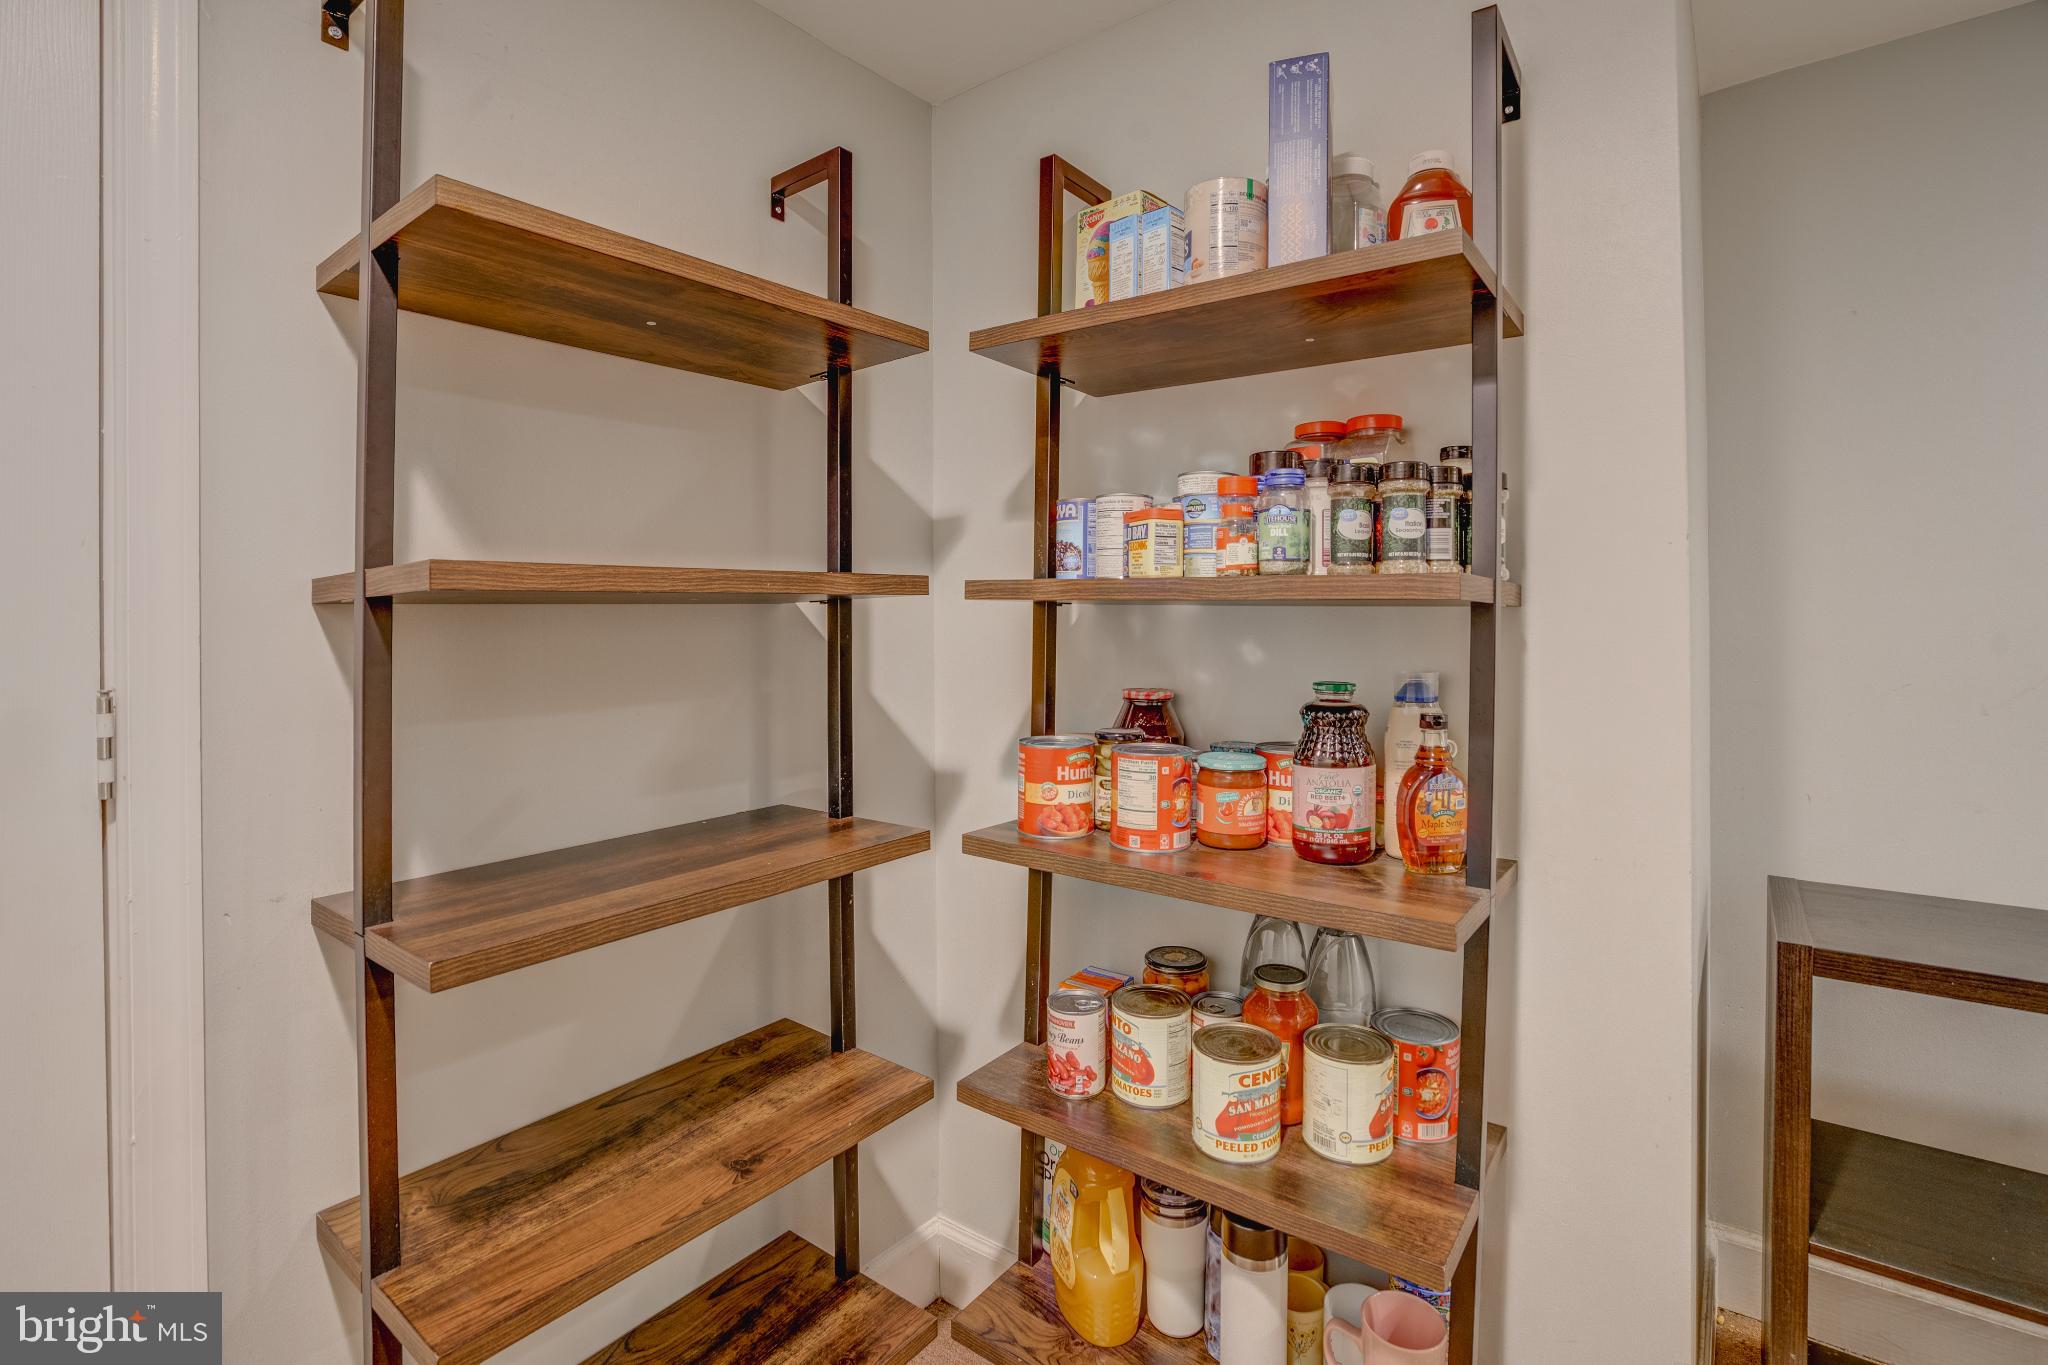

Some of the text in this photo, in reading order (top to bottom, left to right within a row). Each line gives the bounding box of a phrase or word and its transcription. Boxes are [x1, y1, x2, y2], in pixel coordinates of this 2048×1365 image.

[1268, 770, 1292, 787] Hu
[1067, 789, 1091, 800] Diced
[1279, 796, 1290, 806] Di
[1421, 820, 1444, 830] Maple
[1215, 1139, 1259, 1153] PEELED
